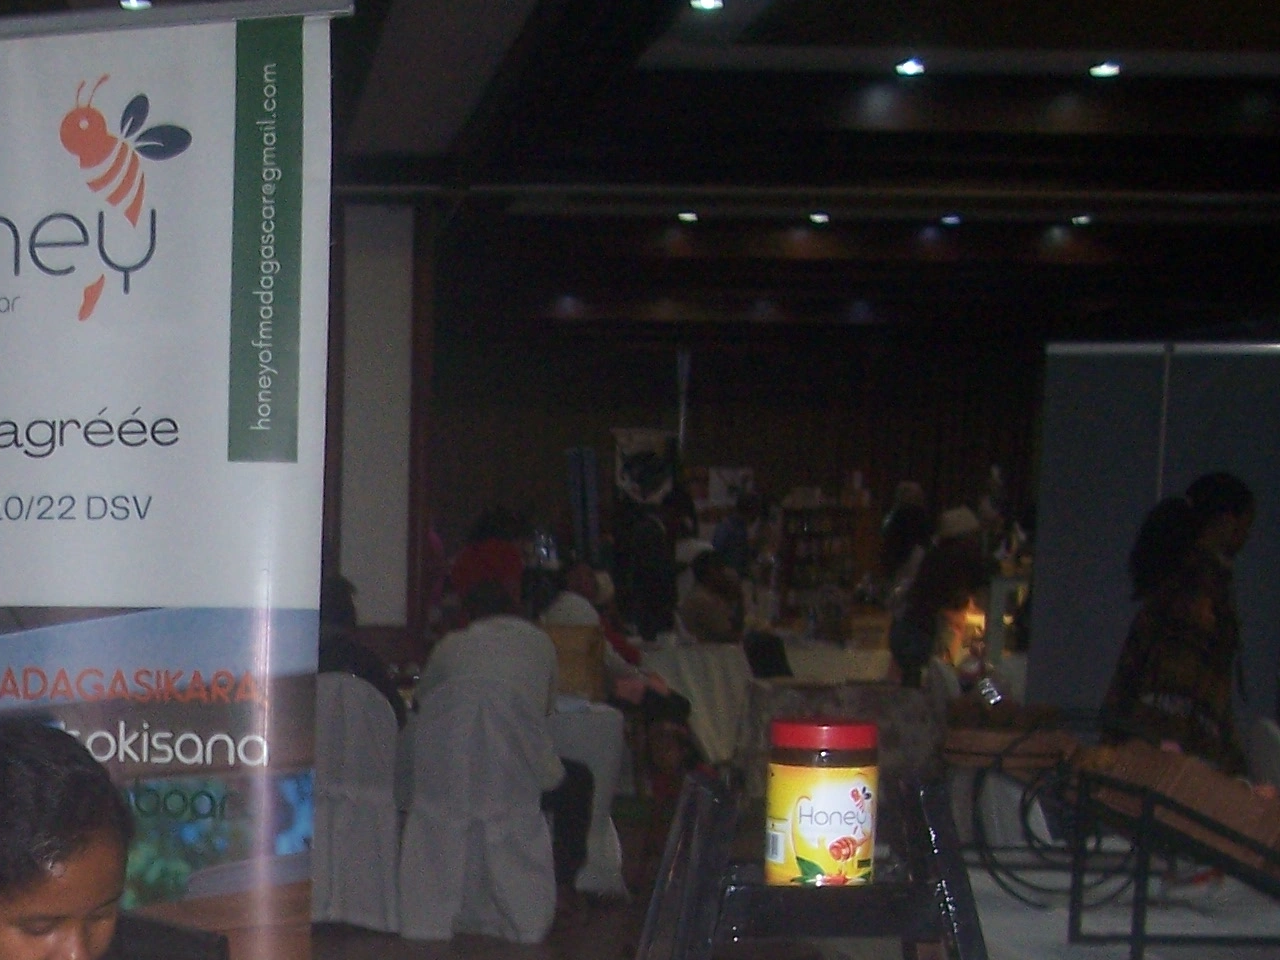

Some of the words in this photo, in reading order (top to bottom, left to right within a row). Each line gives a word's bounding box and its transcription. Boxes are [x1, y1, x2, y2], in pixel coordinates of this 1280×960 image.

[250, 62, 282, 431] honeyofmadagascar@gmail.com
[86, 495, 153, 520] DSV
[798, 805, 868, 828] Honey
